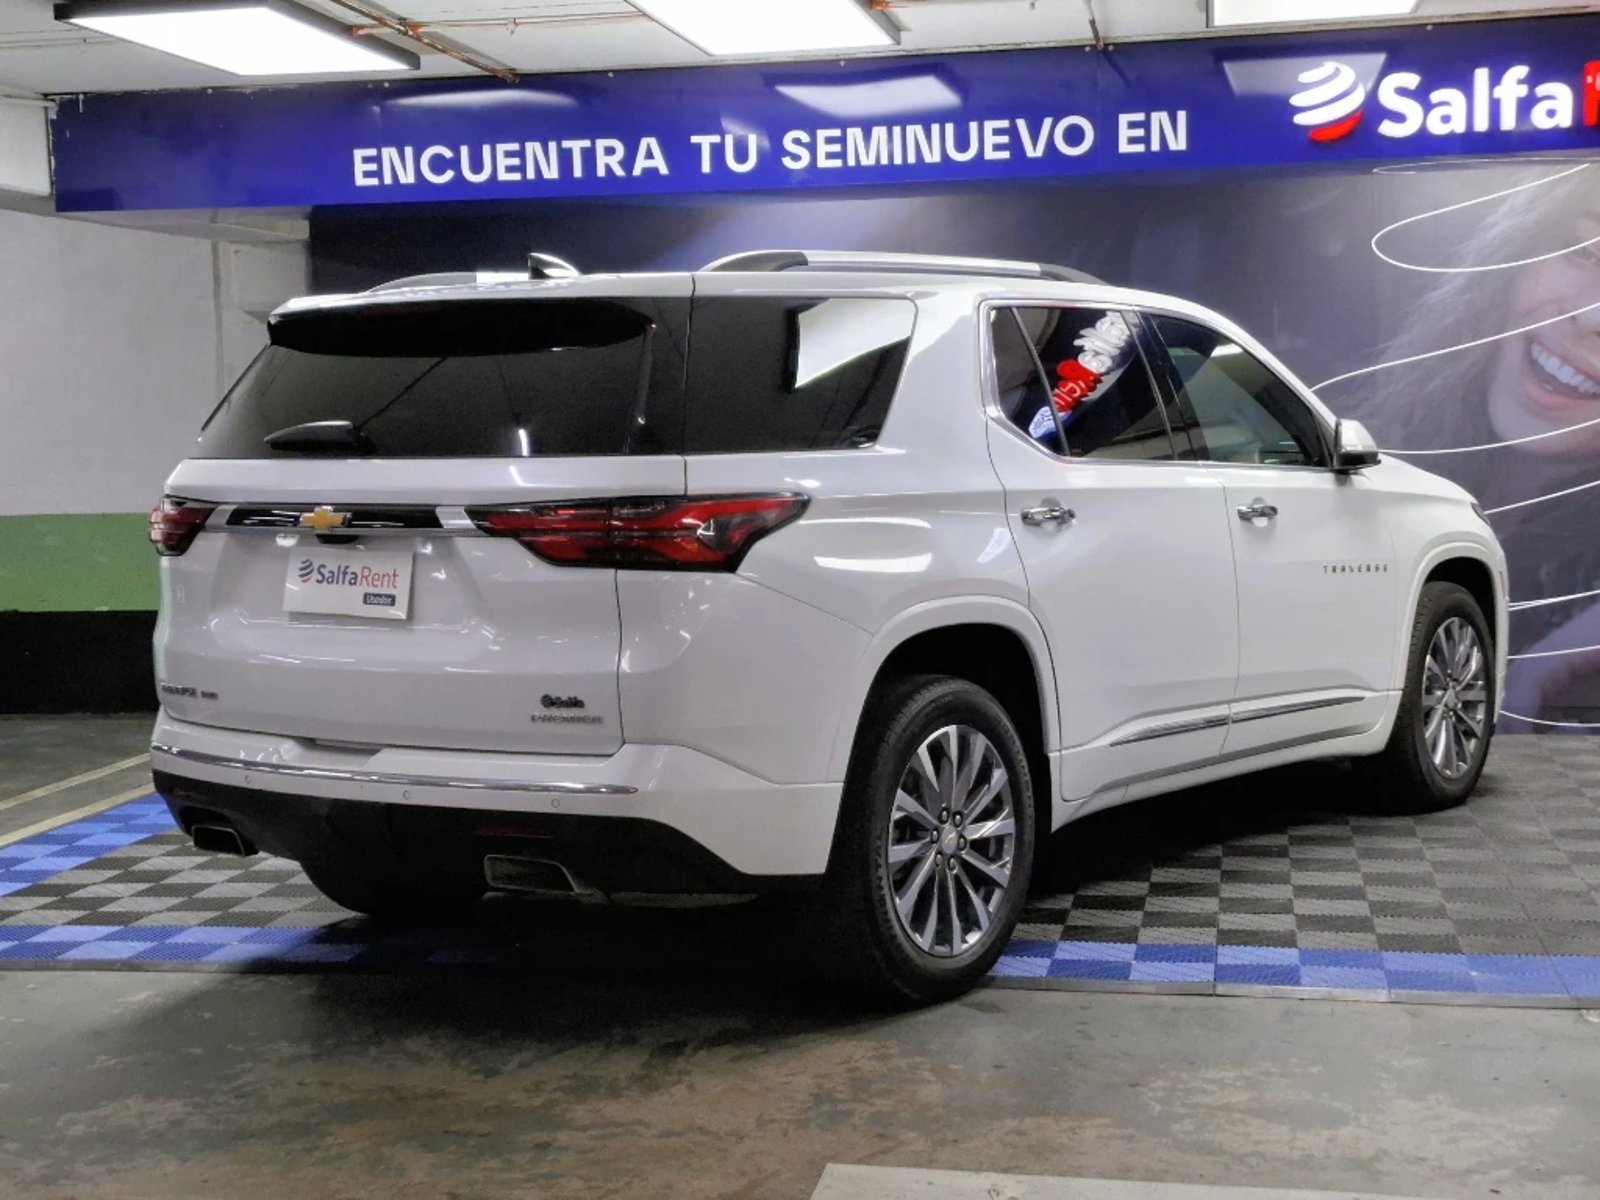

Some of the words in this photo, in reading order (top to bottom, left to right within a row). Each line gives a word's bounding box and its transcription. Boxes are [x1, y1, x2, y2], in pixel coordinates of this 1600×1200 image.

[353, 136, 669, 187] ENCUENTRA
[690, 133, 758, 174] TU
[781, 114, 1095, 170] SEMINUEVO
[1117, 110, 1188, 154] EN
[316, 563, 399, 589] SalfaRent
